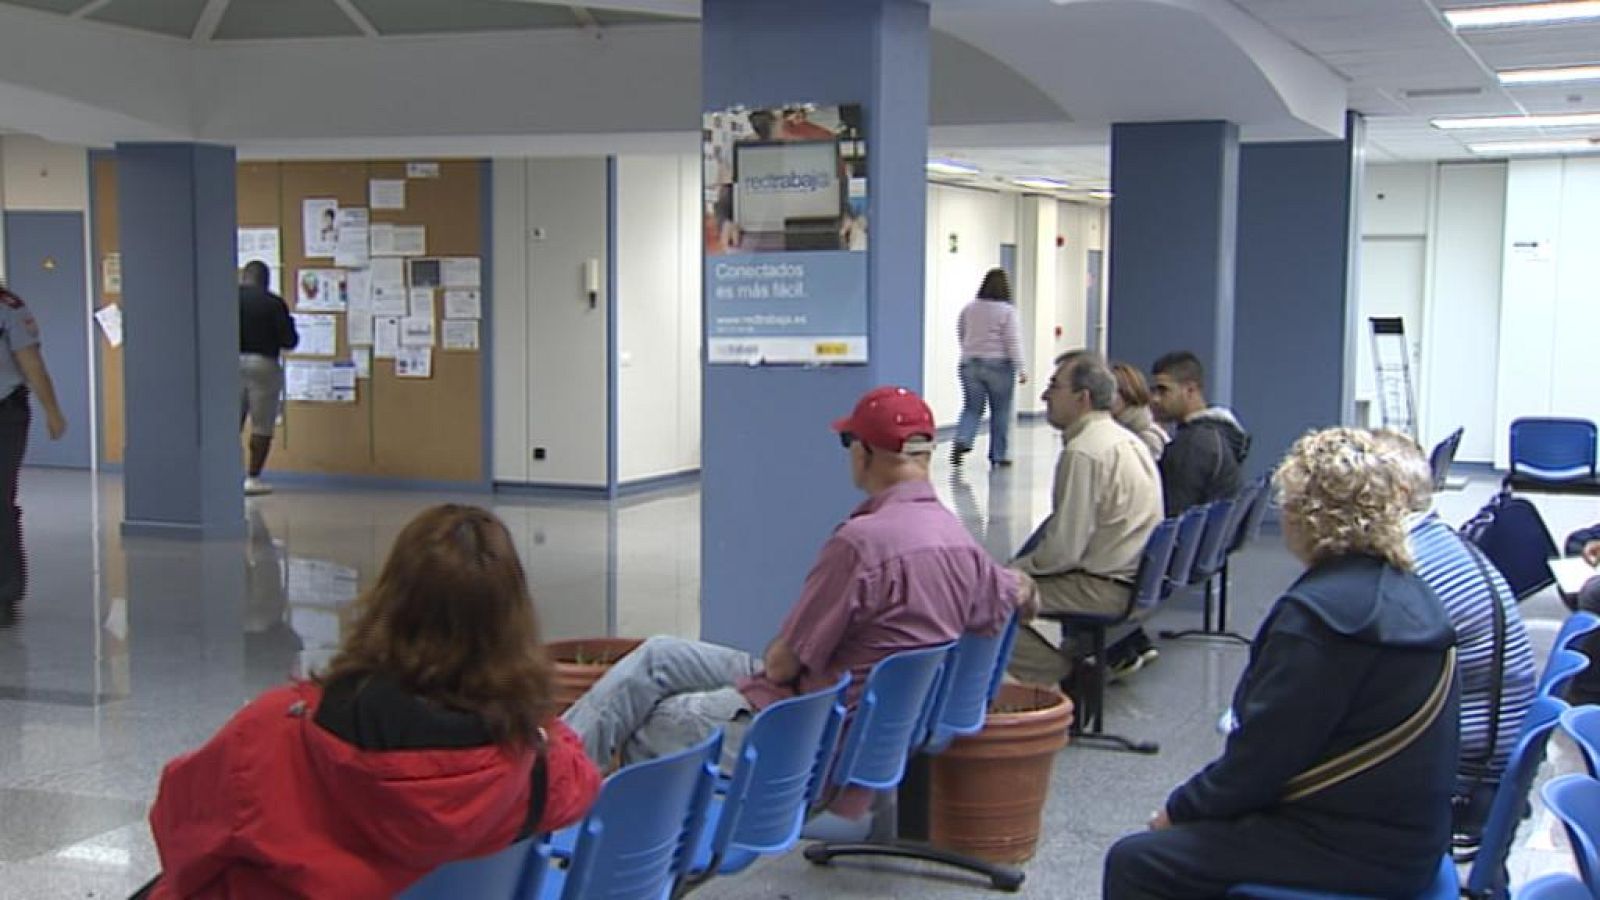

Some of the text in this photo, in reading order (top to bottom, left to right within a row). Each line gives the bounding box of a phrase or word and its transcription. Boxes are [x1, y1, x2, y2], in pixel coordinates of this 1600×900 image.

[716, 263, 803, 280] Conectados
[716, 287, 734, 299] es
[737, 282, 768, 298] más
